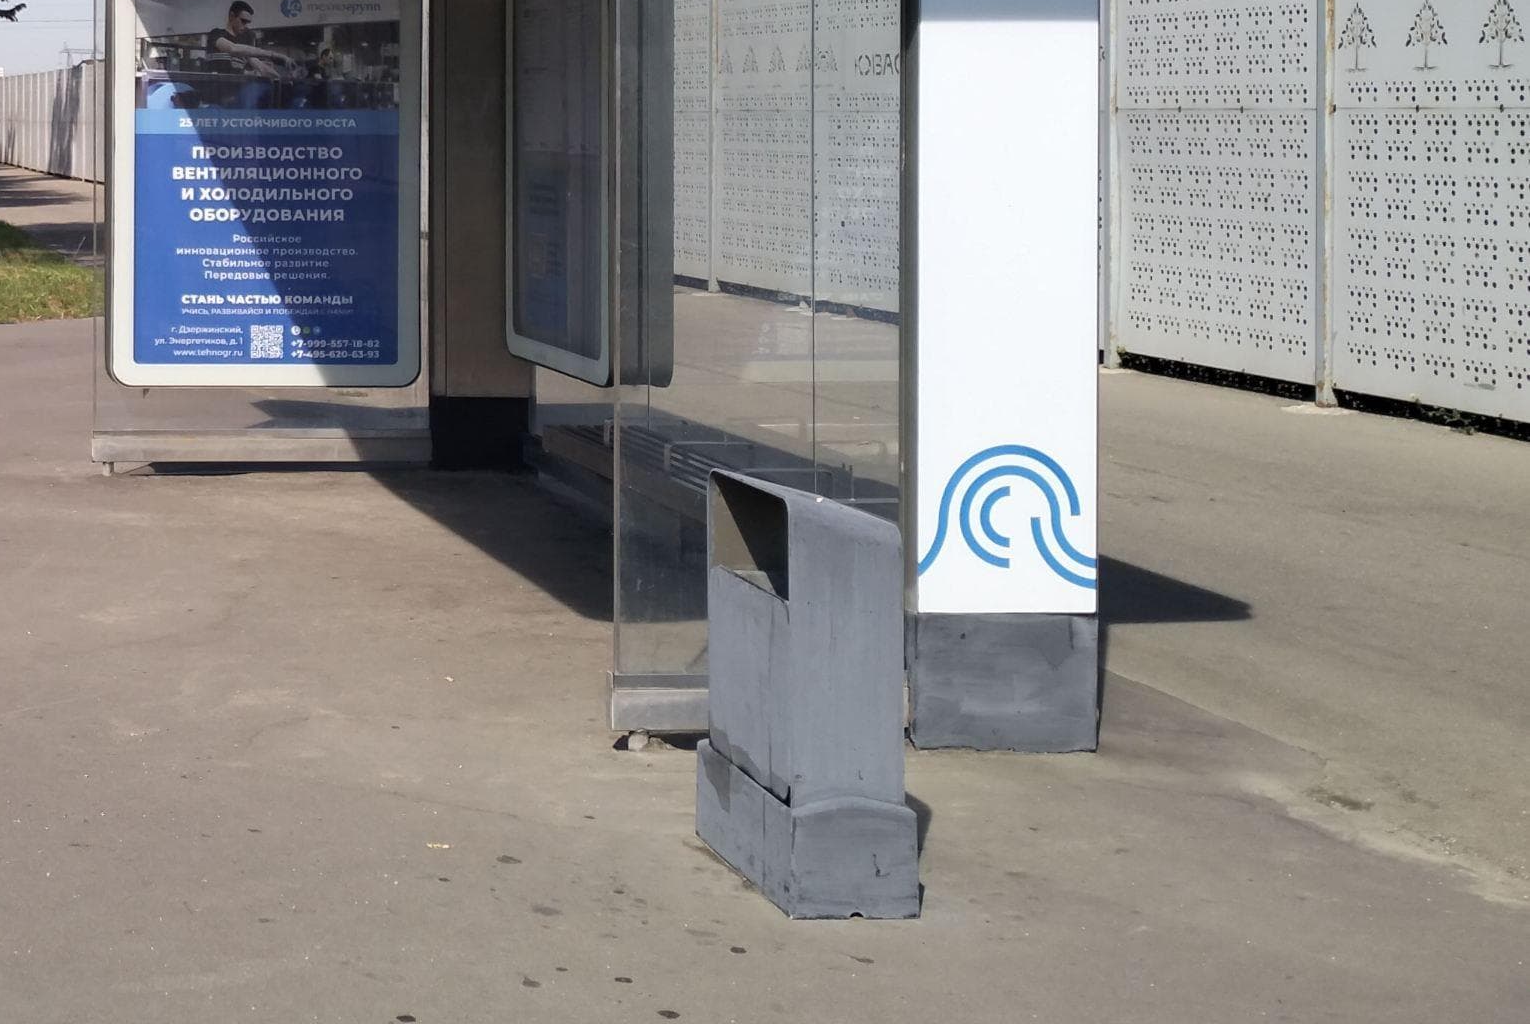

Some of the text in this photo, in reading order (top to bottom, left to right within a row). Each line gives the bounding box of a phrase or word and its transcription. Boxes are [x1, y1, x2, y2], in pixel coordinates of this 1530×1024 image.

[179, 116, 357, 128] 25 ЛЕТ УСТОЙЧИВОГО РОСТА
[192, 145, 343, 162] ПРОИЗВОДСТВО
[172, 166, 363, 183] ВЕНТИЛЯЦИОННОГО
[181, 187, 354, 203] И ХОЛОДИЛЬНОГО
[189, 207, 345, 224] ОБОРУДОВАНИЯ
[232, 232, 302, 244] Российское
[176, 247, 269, 257] инновационное
[202, 257, 271, 269] Стабильное
[204, 270, 331, 282] Передовые решения.
[181, 294, 353, 306] СТАНЬ ЧАСТЬЮ КОМАНДЫ
[169, 337, 229, 347] Энергетиков,
[173, 348, 244, 358] www.tehnogr.ru
